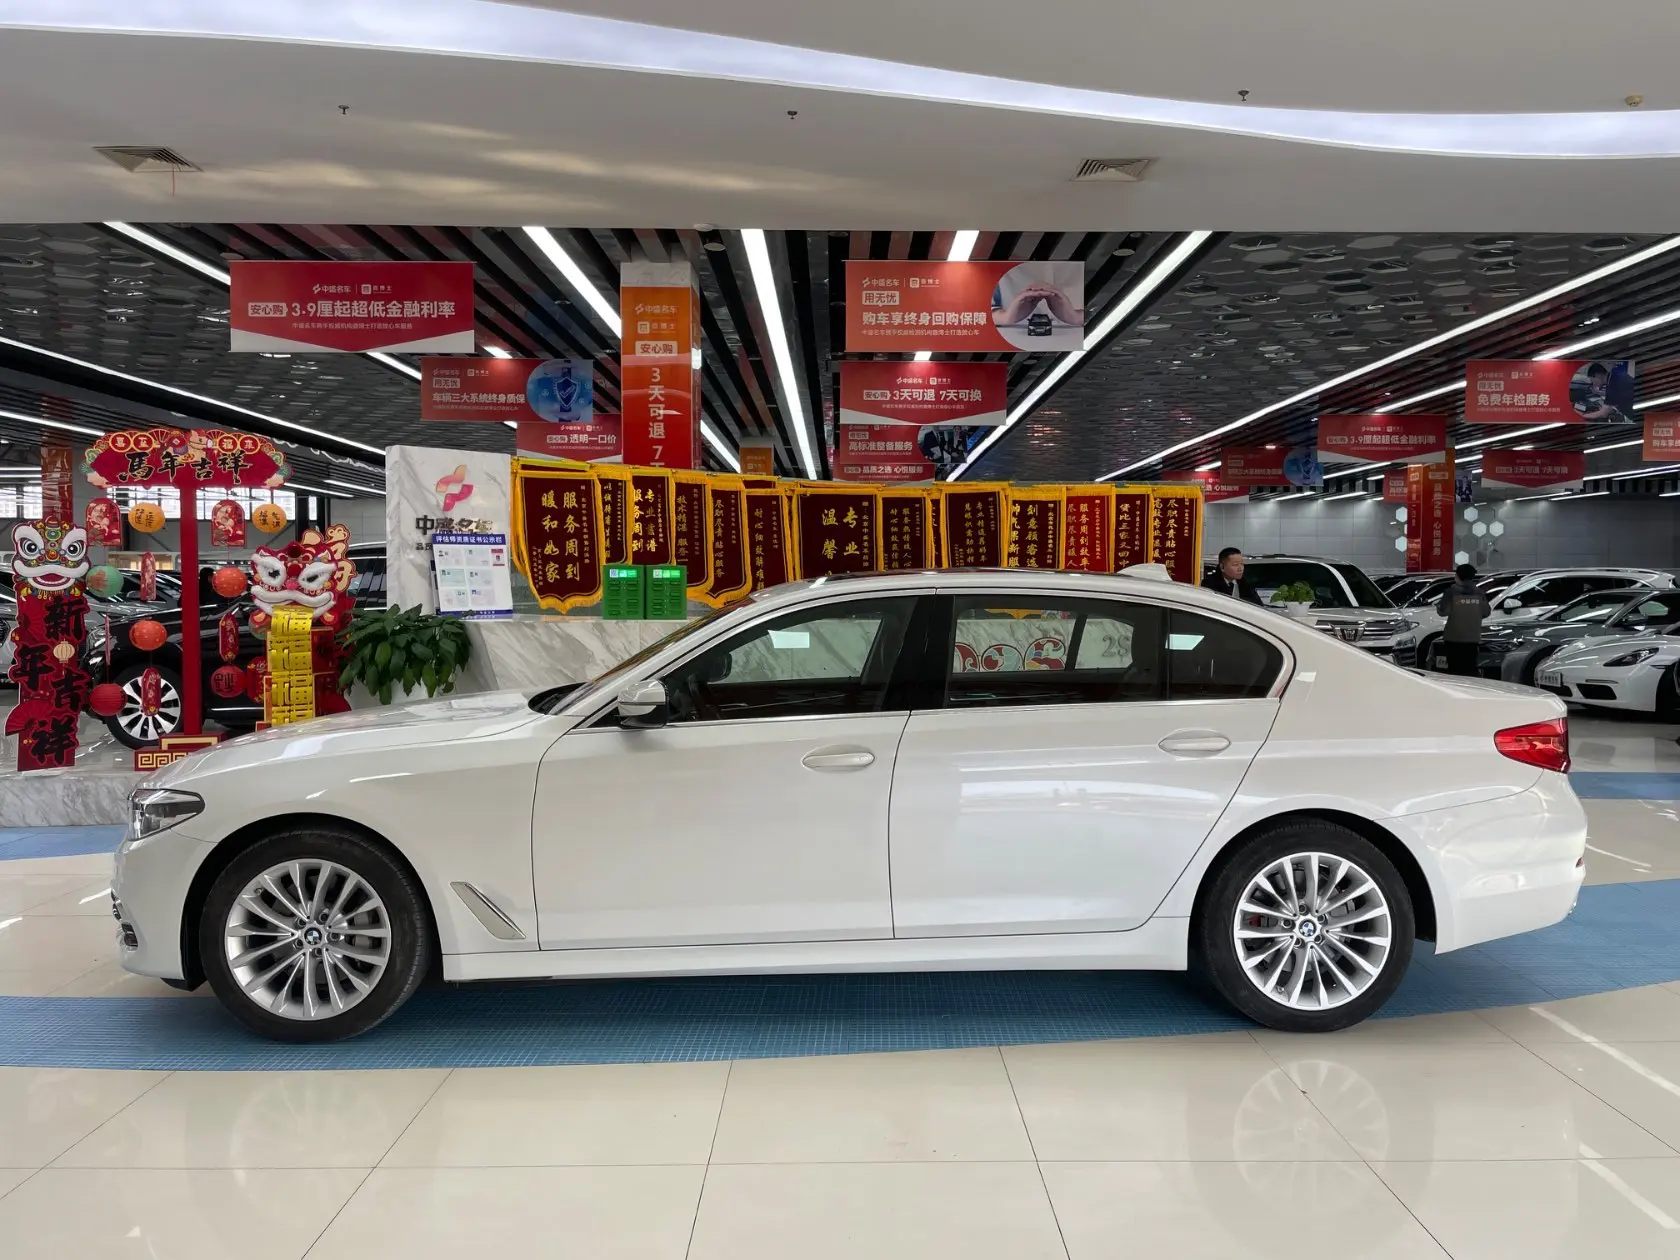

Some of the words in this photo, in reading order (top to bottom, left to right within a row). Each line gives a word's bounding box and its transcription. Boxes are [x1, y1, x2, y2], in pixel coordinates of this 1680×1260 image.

[864, 292, 897, 303] 用无忧
[250, 304, 284, 315] 安心购
[291, 300, 456, 318] 3.9厘起超低金融利率
[862, 312, 987, 326] 购车享终身回购保障
[640, 343, 673, 354] 安心购
[433, 393, 526, 404] 车辆三大系统终身质保
[893, 389, 936, 401] 3天可退
[939, 389, 982, 401] 7天可换
[1477, 393, 1550, 406] 免费年检服务
[648, 367, 666, 439] 3天可退
[569, 434, 616, 444] 透明一口价
[849, 441, 913, 451] 高标准整备服务
[863, 466, 892, 474] 品质之选
[676, 495, 688, 532] 技术精湛
[541, 489, 560, 584] 暖和如家
[563, 491, 580, 582] 服务周到
